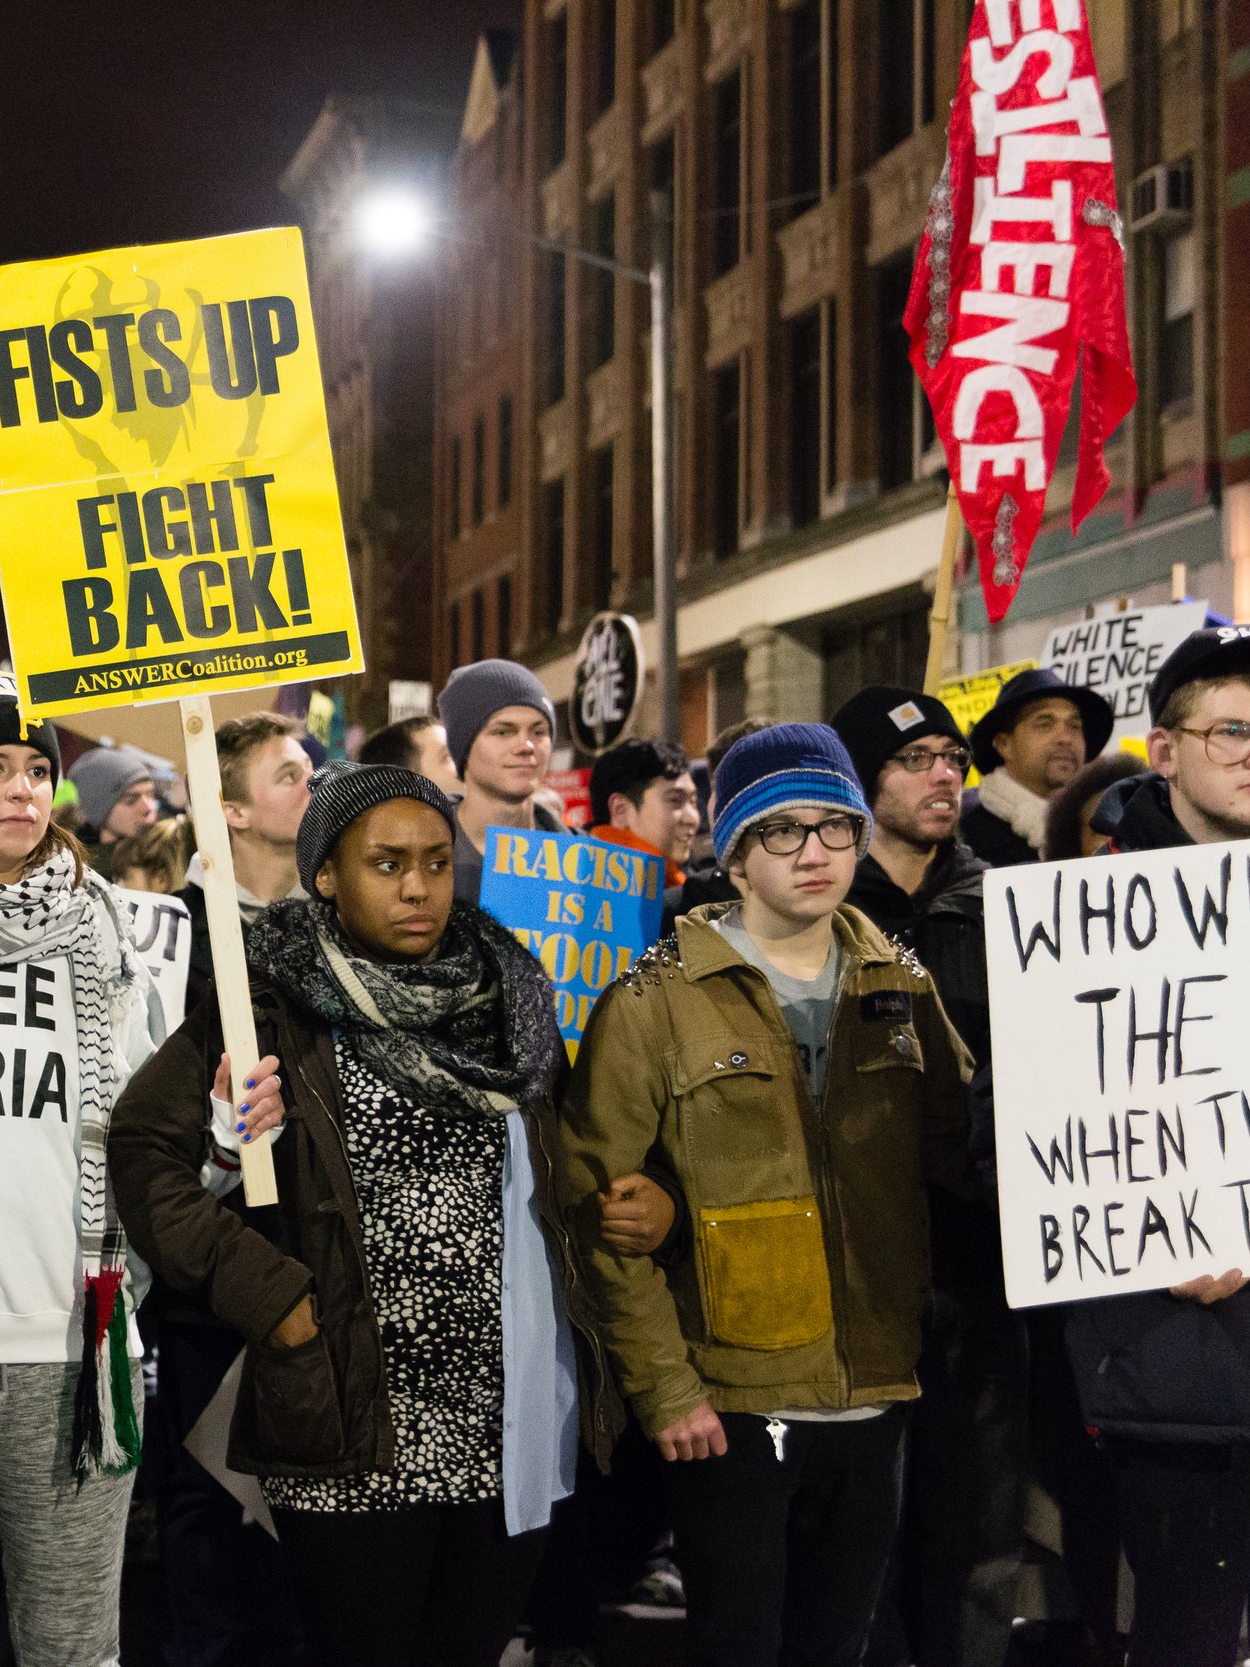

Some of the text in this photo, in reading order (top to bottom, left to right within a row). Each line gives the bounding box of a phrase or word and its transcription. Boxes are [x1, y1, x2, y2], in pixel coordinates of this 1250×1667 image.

[201, 295, 300, 400] UP
[76, 473, 275, 570] FIGHT
[61, 548, 313, 657] BACK!
[1052, 615, 1143, 658] WHITE
[73, 646, 308, 695] ANSWERCoalition.org
[493, 832, 658, 900] RACISM
[545, 890, 614, 933] IS A
[1005, 850, 1250, 973] WHO W
[1073, 974, 1229, 1096] THE
[1024, 1103, 1188, 1187] WHEN
[1039, 1187, 1213, 1286] BREAK
